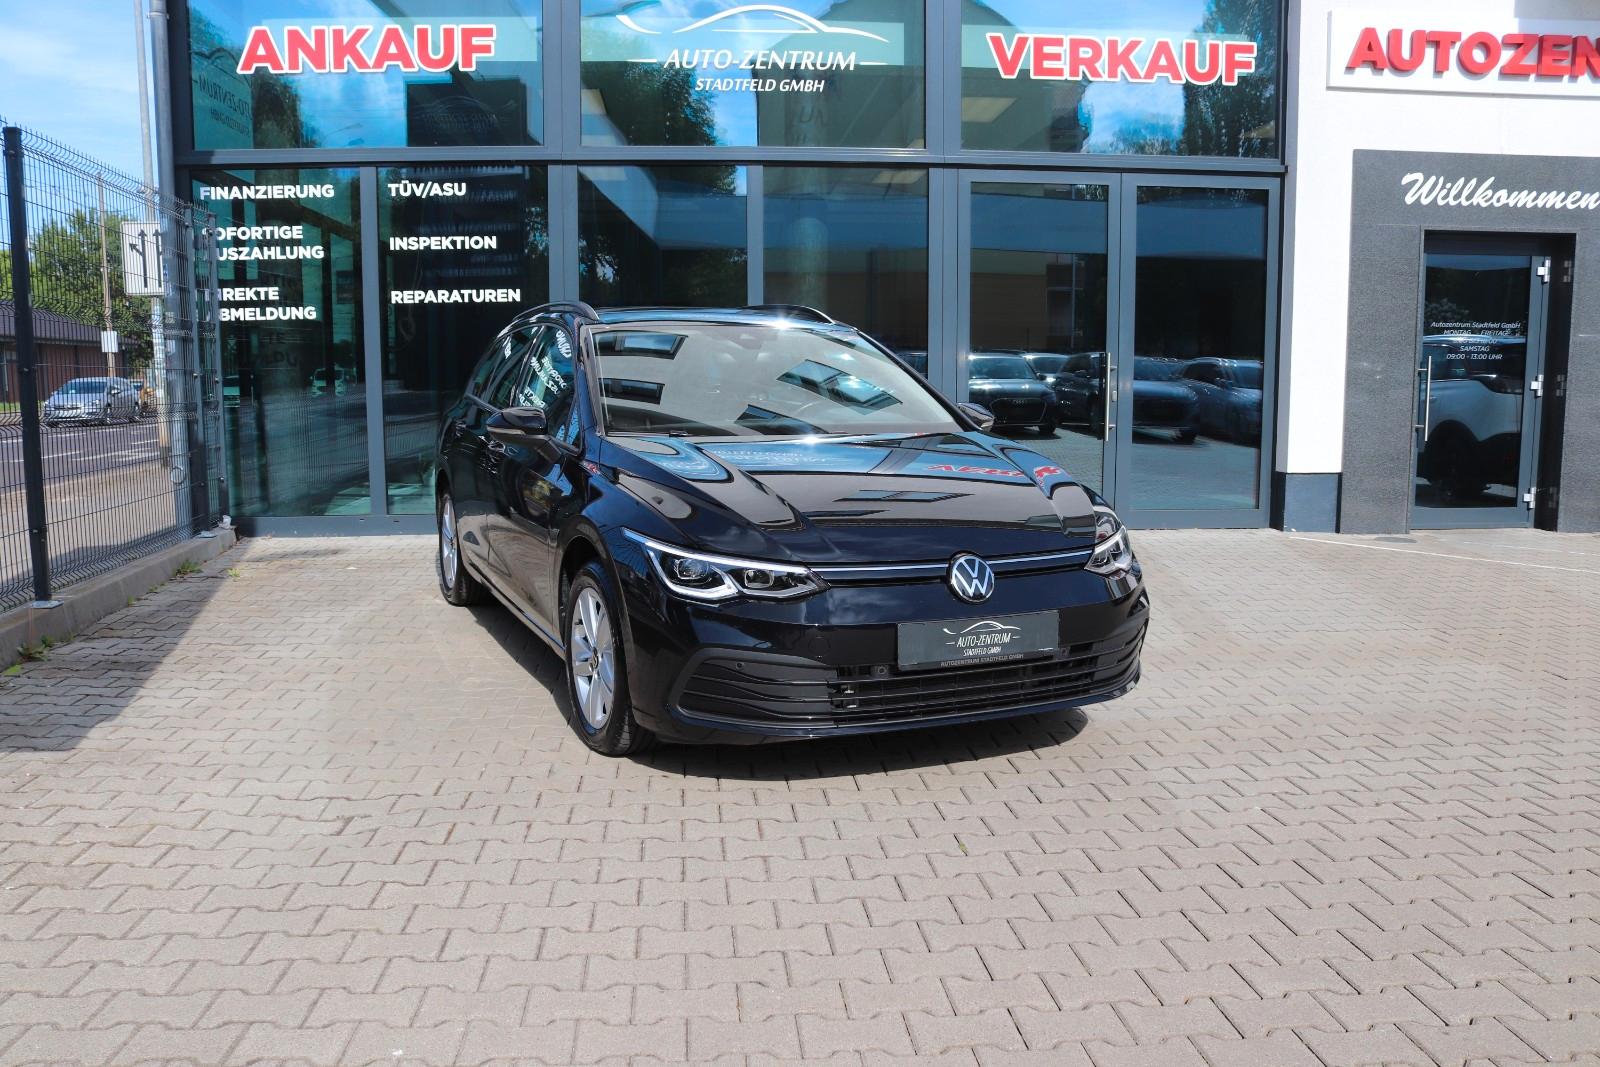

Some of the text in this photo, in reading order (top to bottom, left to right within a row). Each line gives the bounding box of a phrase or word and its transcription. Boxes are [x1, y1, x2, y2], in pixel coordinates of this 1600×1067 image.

[237, 24, 496, 74] ANKAUF
[1345, 27, 1600, 77] AUTOZEN
[664, 49, 856, 71] AUTO-ZENTRUM
[986, 33, 1257, 86] VERKAUF
[695, 78, 825, 93] STADTFELD GMBH
[200, 184, 335, 200] FINANZIERUNG
[388, 180, 467, 198] TÜV/ASU
[1401, 172, 1600, 210] Willkommen
[389, 236, 497, 250] INSPEKTION
[217, 245, 325, 260] USZAHLUNG
[390, 289, 521, 304] REPARATUREN
[207, 306, 317, 321] BMELDUNG
[956, 632, 1011, 648] AUTO-ZENTRUM
